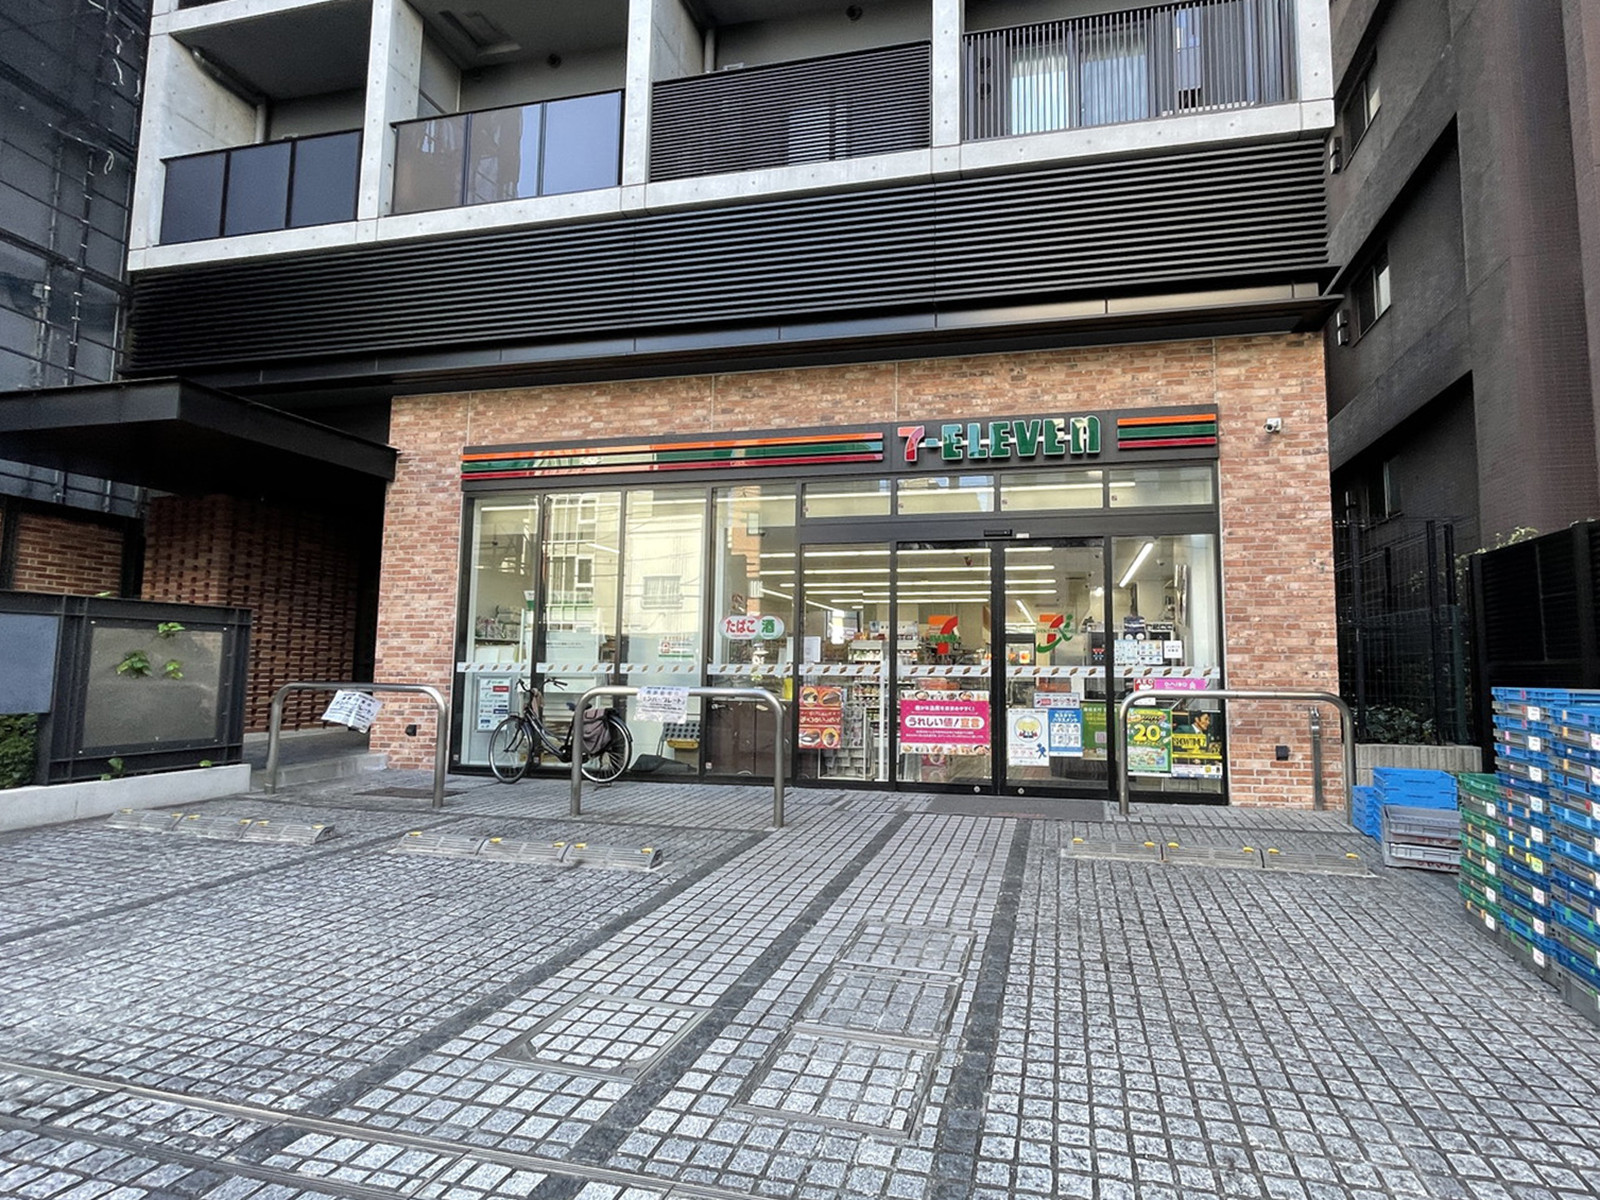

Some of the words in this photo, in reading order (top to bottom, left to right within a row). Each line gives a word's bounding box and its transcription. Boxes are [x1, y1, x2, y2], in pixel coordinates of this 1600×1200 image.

[725, 619, 756, 633] たばこ
[761, 619, 775, 633] 酒
[1133, 724, 1161, 742] 20
